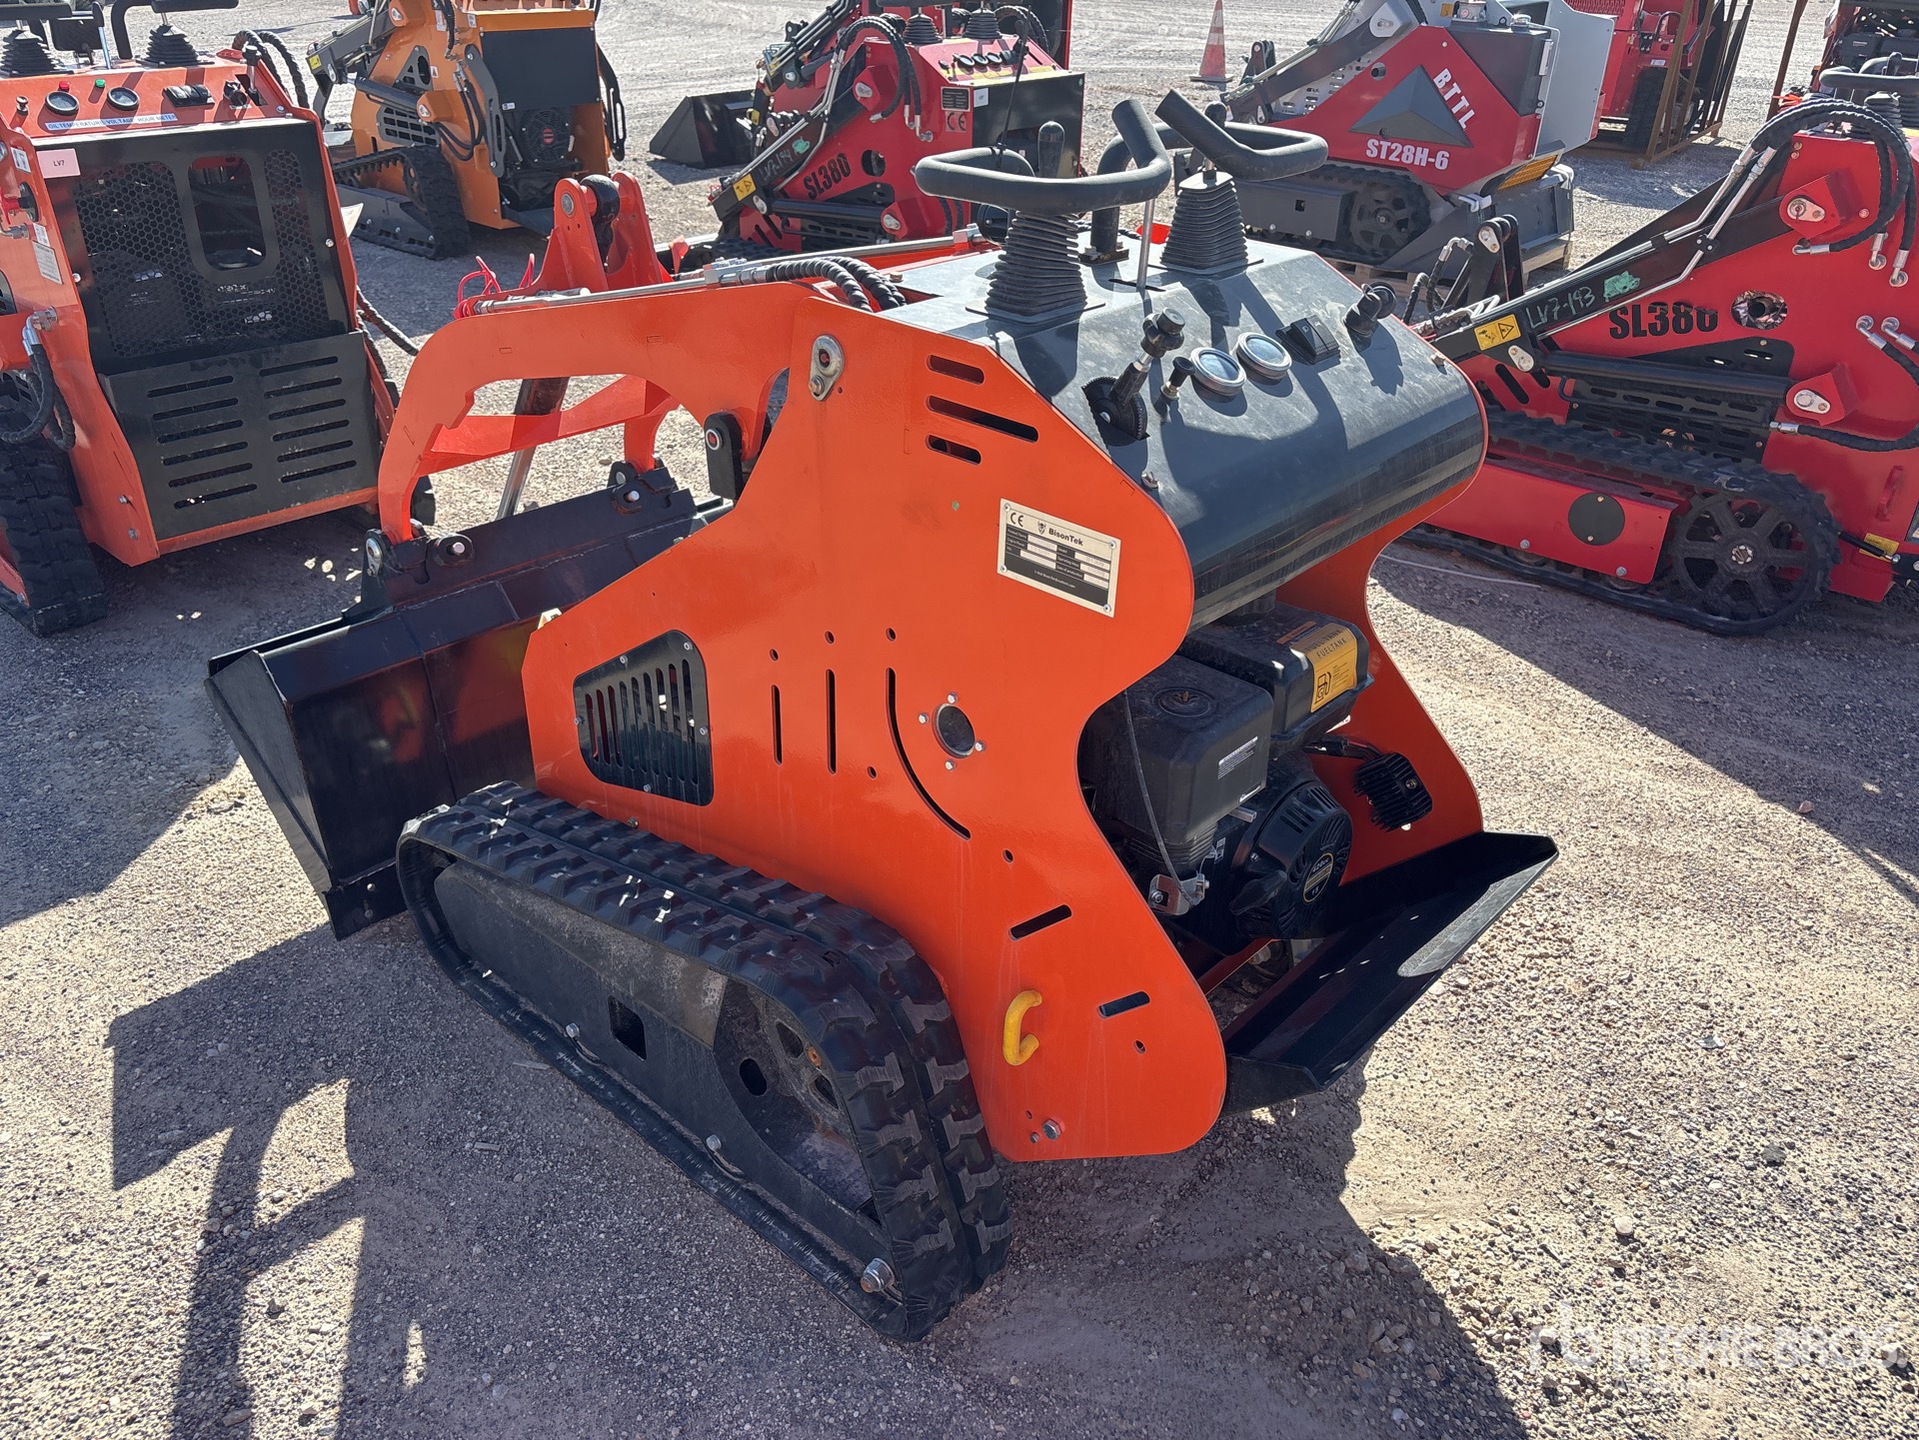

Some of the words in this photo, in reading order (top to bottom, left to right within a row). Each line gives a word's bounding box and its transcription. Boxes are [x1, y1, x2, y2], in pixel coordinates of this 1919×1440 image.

[1433, 68, 1475, 130] BTTL
[59, 118, 104, 129] TEMPERATURE
[105, 116, 133, 126] VOLTAGE
[1366, 139, 1450, 170] ST28H-6
[803, 153, 851, 200] SL380
[1526, 286, 1596, 329] LV7-193
[1608, 301, 1719, 340] SL380
[1048, 527, 1084, 547] BisonTek
[1316, 637, 1348, 659] FUELTANK
